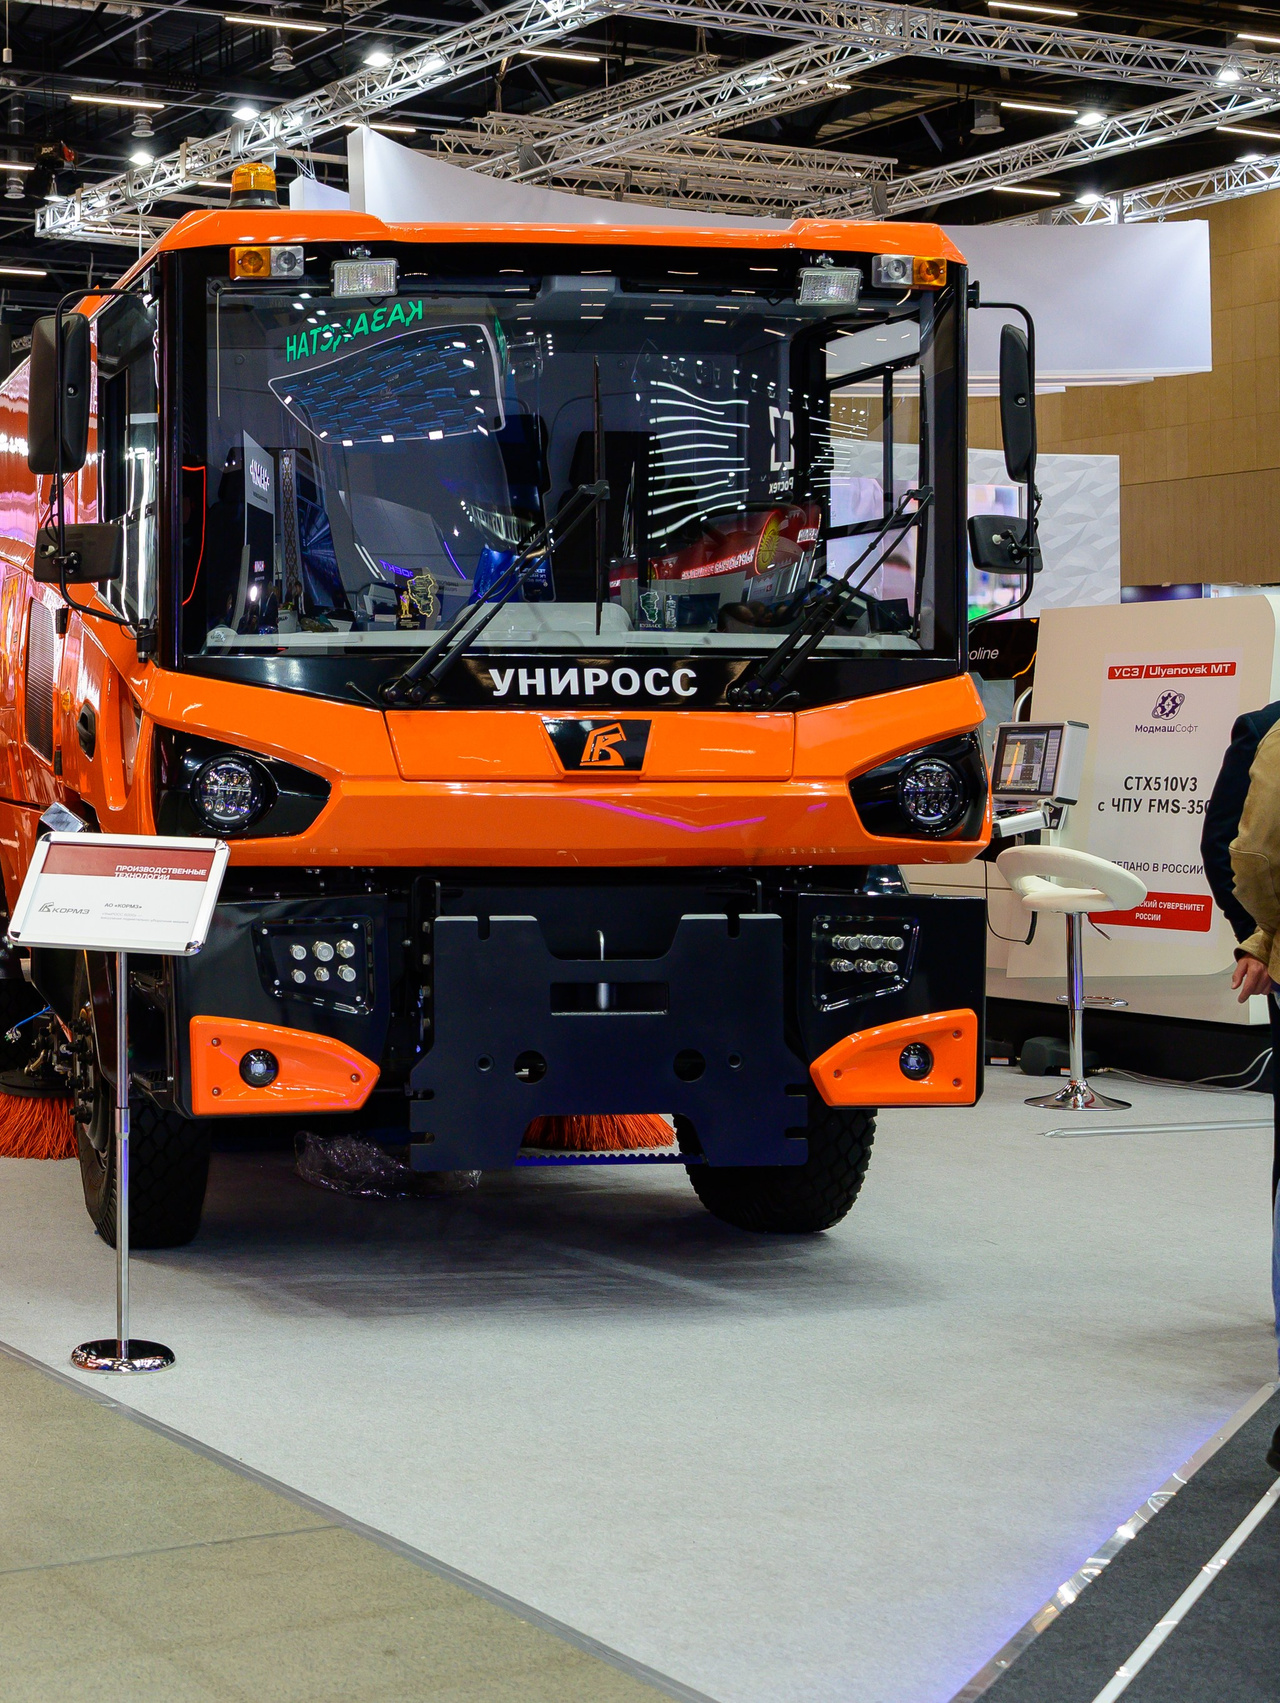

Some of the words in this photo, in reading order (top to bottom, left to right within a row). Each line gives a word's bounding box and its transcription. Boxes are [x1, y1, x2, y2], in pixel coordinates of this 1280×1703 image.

[968, 647, 999, 661] oline
[1114, 667, 1140, 678] УСЗ
[1149, 665, 1208, 678] Ulyanovsk
[1210, 664, 1231, 674] MT
[488, 667, 698, 696] УНИРОСС
[1134, 724, 1198, 734] МодмашСофт
[1124, 776, 1198, 792] CTX510V3
[1098, 801, 1105, 812] с
[1111, 798, 1142, 813] ЧПУ
[115, 865, 207, 877] ПРОИЗВОДСТВЕННЫЕ
[1111, 861, 1150, 872] ЕЛАНО
[1152, 863, 1159, 872] В
[1162, 863, 1203, 874] РОССИИ
[114, 872, 170, 881] ТЕХНОЛОГИИ
[52, 907, 90, 915] КОРМЗ
[1158, 900, 1205, 912] СУВЕРЕНИТЕТ
[1135, 912, 1162, 922] РОССИИ
